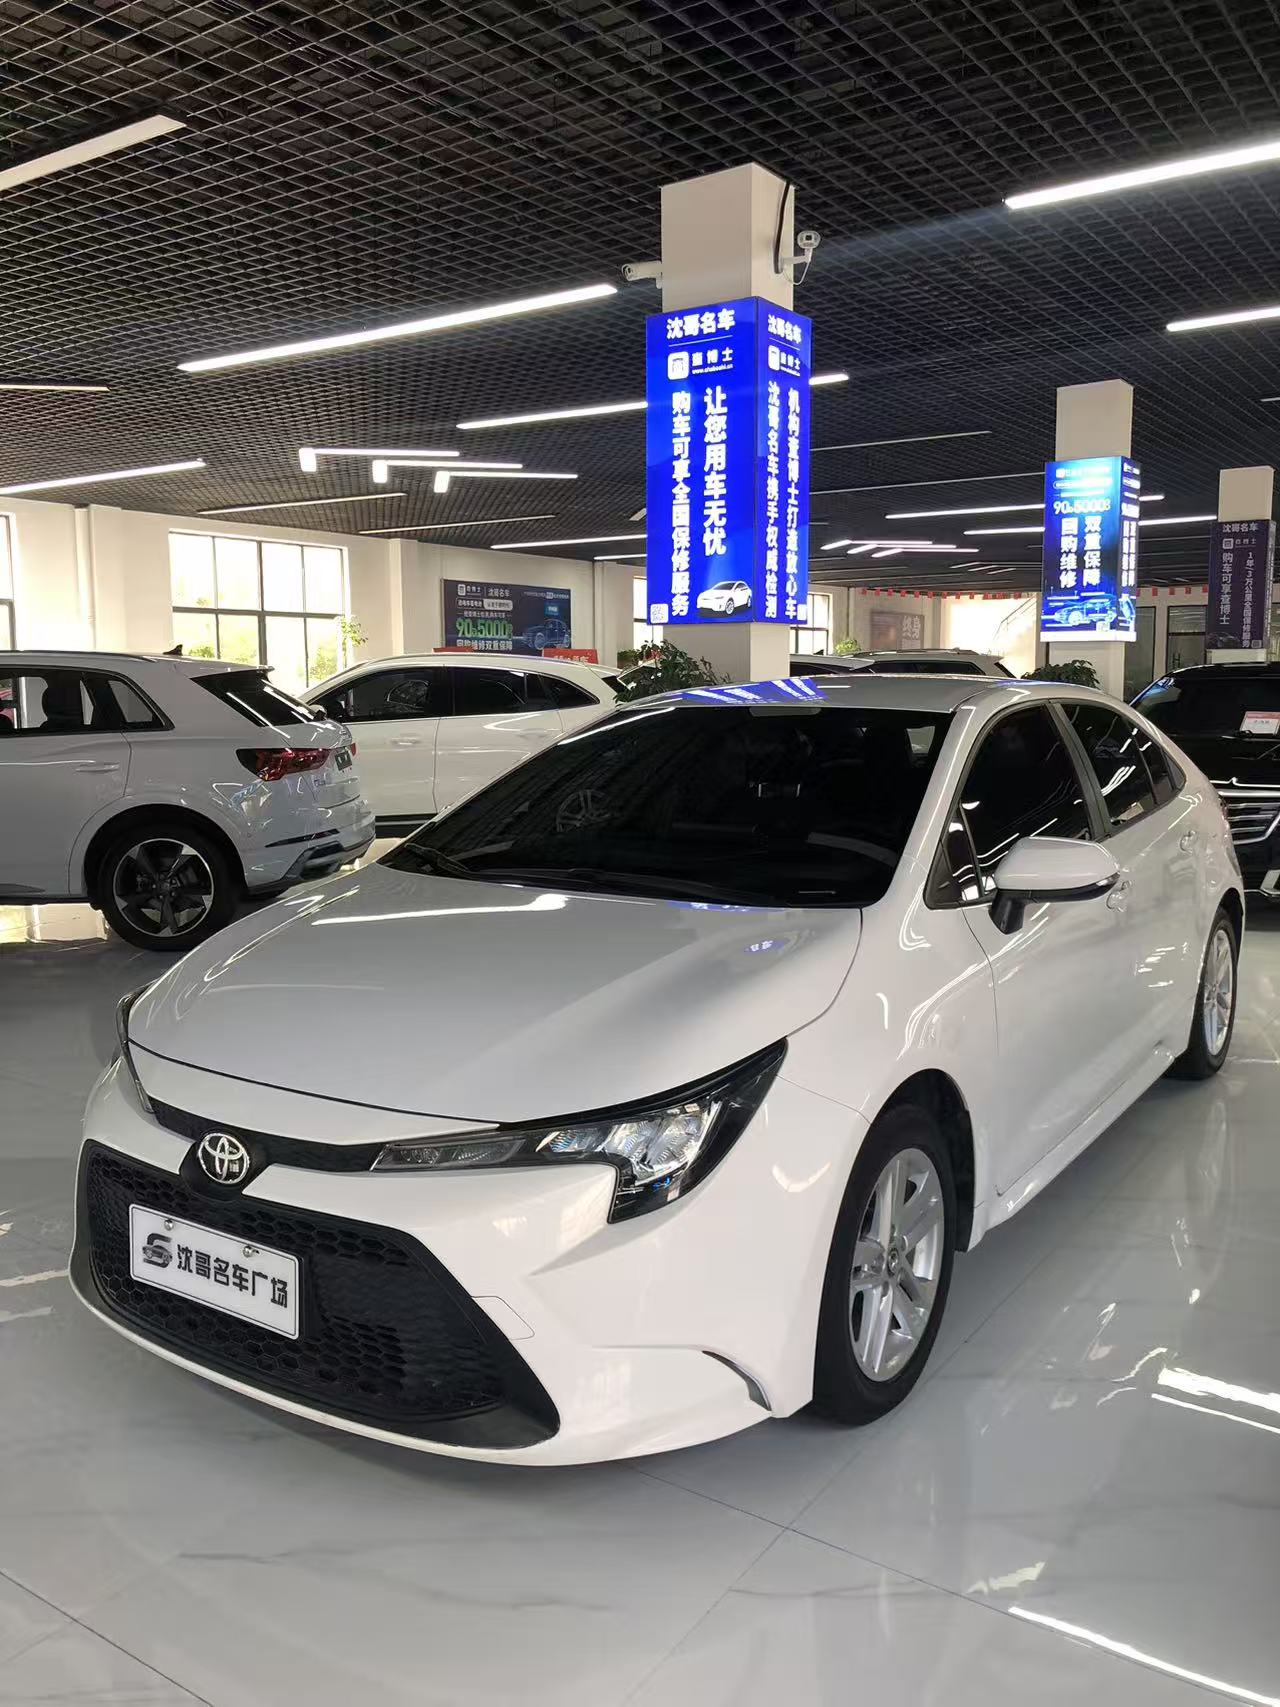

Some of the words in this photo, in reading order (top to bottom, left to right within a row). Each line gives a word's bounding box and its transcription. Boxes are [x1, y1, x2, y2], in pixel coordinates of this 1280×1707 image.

[666, 308, 735, 339] 沈哥名车
[768, 314, 802, 344] 沈哥名车
[671, 390, 692, 616] 购车可享全国保修服务
[703, 385, 728, 556] 让您用车无忧
[1222, 523, 1258, 533] 沈哥名车
[1219, 552, 1233, 625] 购车可享查博士
[177, 1243, 288, 1309] 沈哥名车广场
